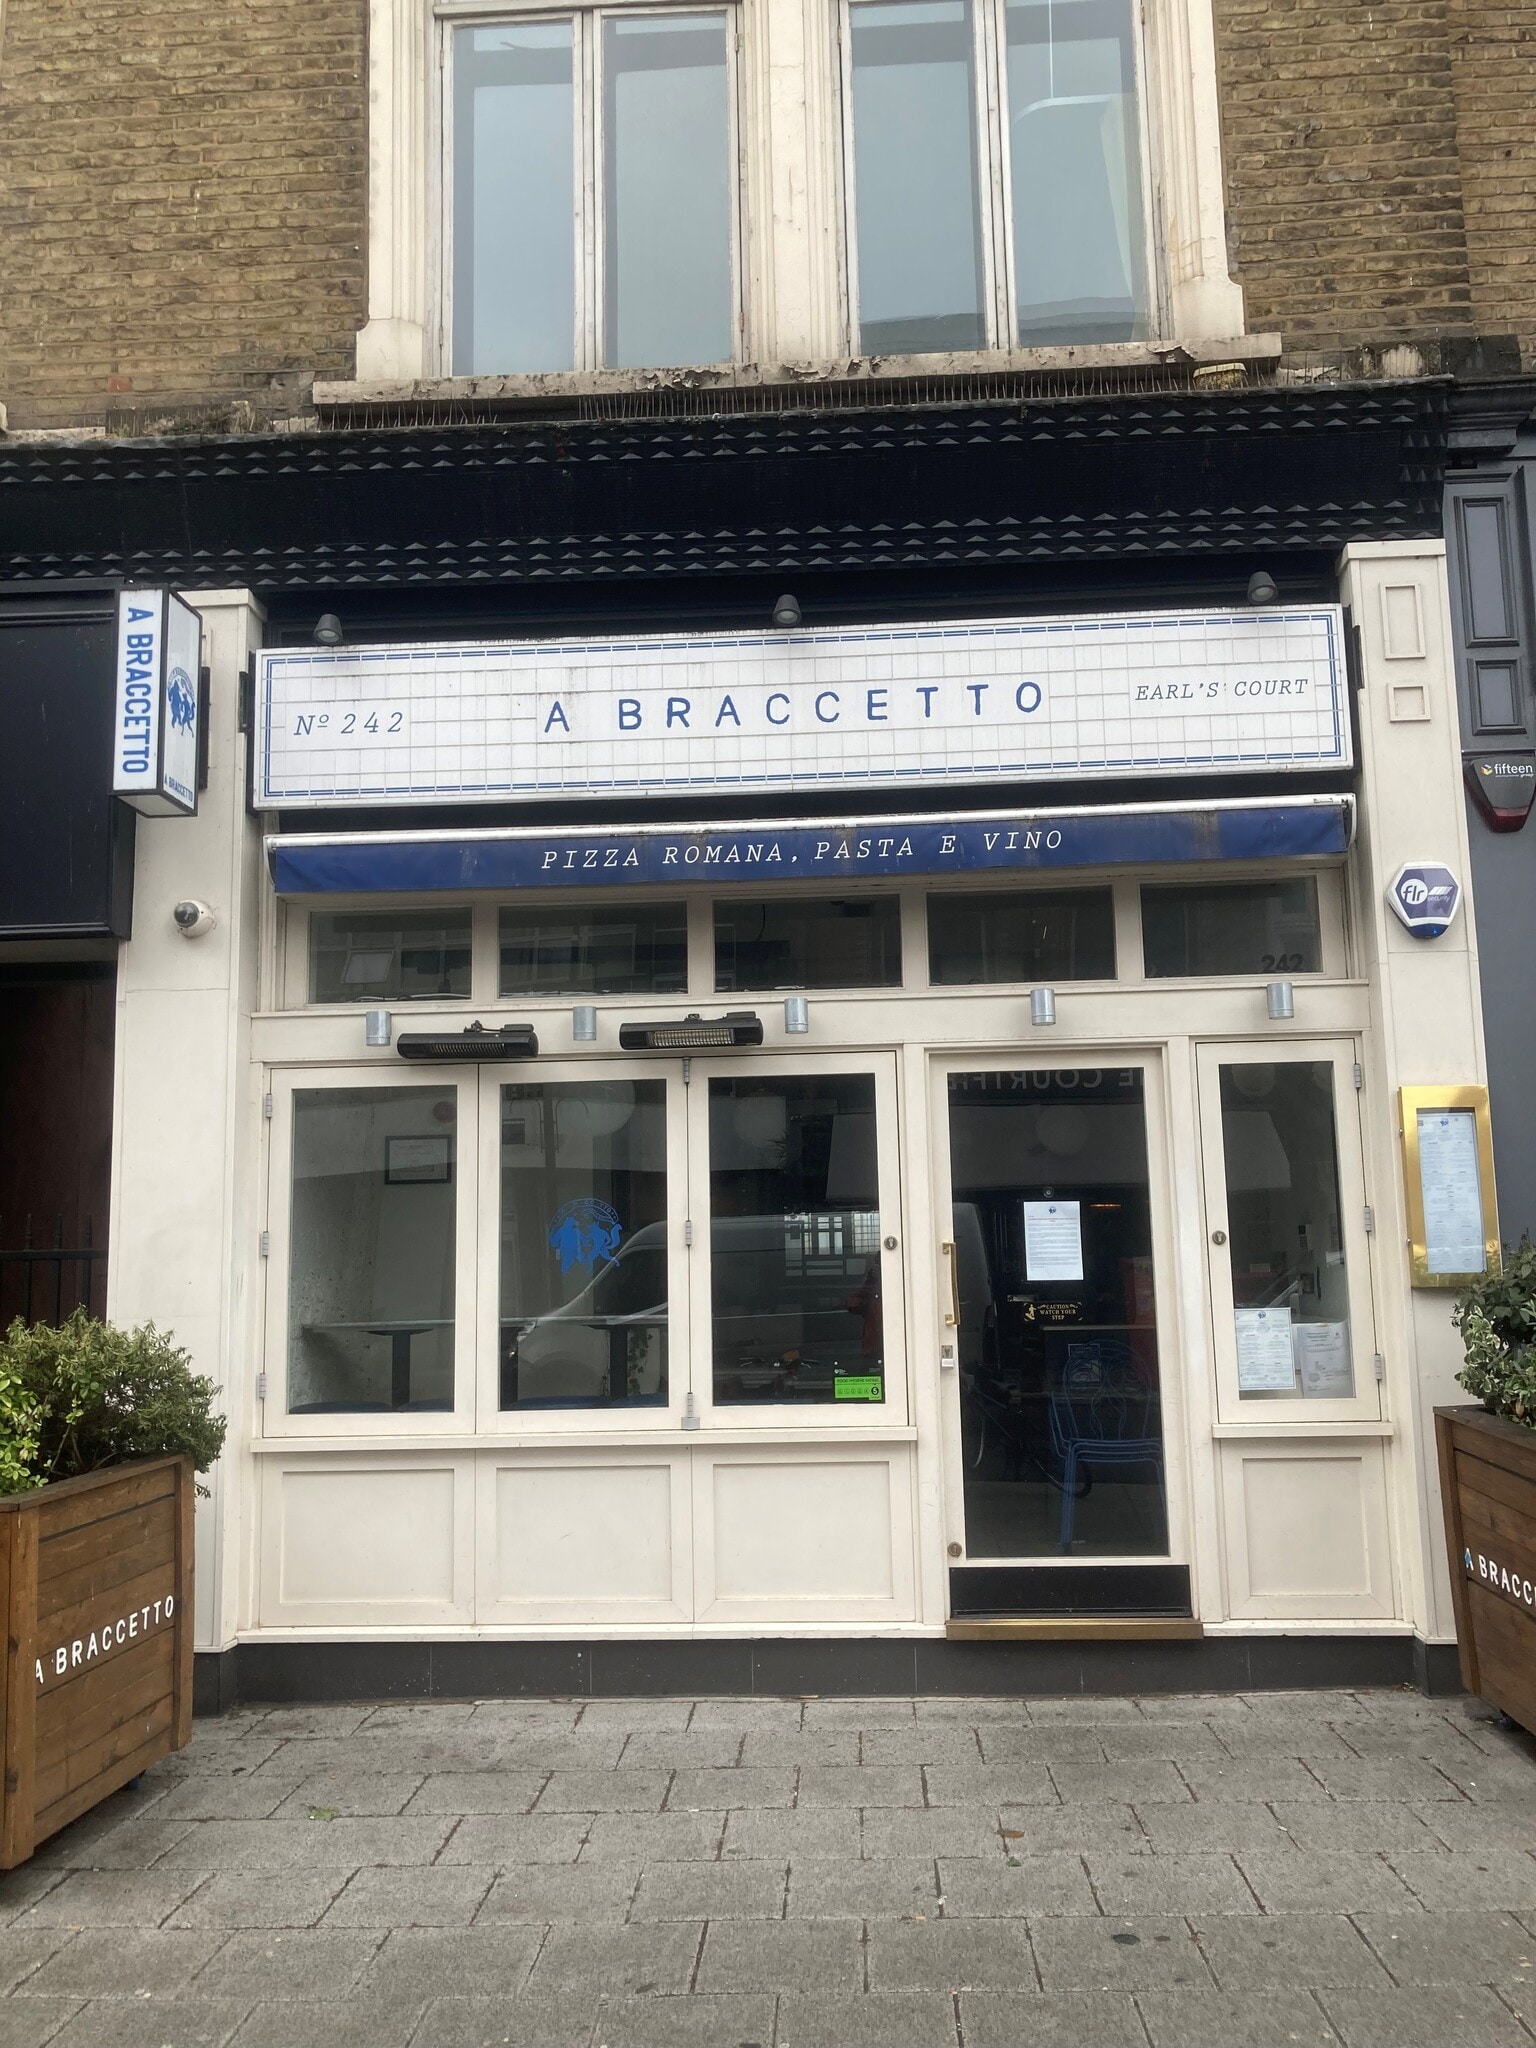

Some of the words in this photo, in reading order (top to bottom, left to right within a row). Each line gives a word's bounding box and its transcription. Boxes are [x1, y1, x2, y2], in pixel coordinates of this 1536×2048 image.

[127, 607, 154, 623] A
[1234, 679, 1309, 697] COURT
[122, 633, 154, 774] BRACCETTO
[544, 701, 570, 733] A
[618, 681, 1042, 730] BRACCETTO
[340, 711, 404, 735] 242
[1494, 763, 1533, 774] fifteen
[541, 847, 639, 869] PIZZA
[662, 842, 798, 866] ROMANA,
[814, 836, 914, 860] PASTA
[939, 835, 957, 854] E
[983, 830, 1062, 851] VINO
[1403, 885, 1424, 901] flr
[1261, 953, 1303, 972] 242
[1464, 1548, 1474, 1571] A
[1478, 1554, 1536, 1606] BRACC
[35, 1657, 44, 1684] A
[56, 1595, 174, 1675] BRACCETTO
